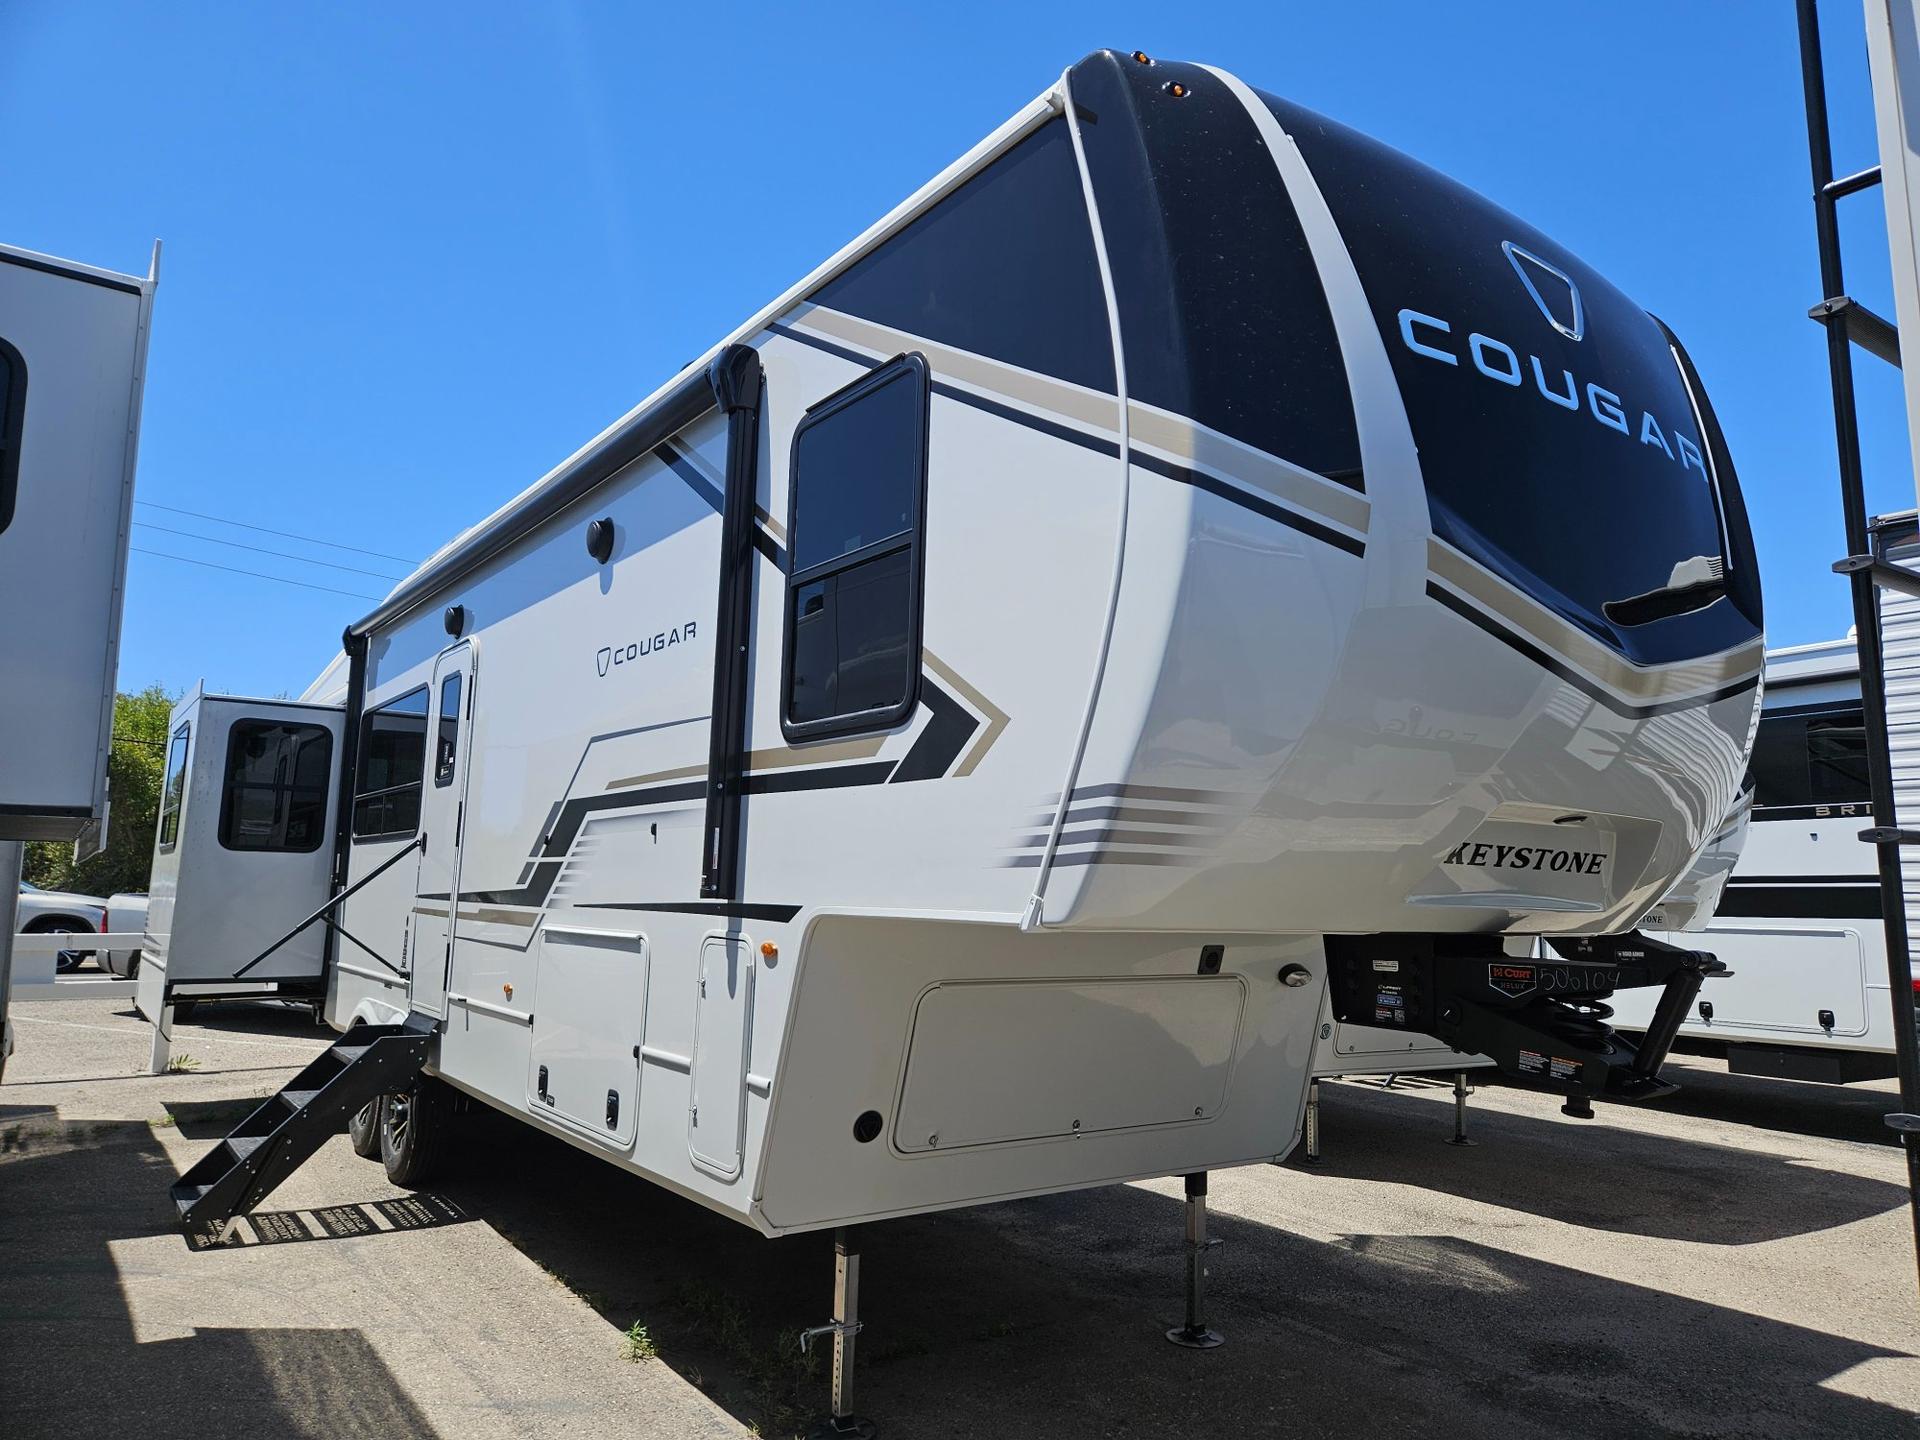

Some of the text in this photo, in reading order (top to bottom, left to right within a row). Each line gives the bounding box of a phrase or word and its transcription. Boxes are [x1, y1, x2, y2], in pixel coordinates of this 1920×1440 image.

[1398, 308, 1709, 483] COUGAR
[614, 621, 696, 665] COUGAR
[1815, 804, 1871, 816] BRI
[1443, 842, 1607, 875] KEYSTONE
[1640, 915, 1663, 924] TONE
[1504, 967, 1532, 978] CURT
